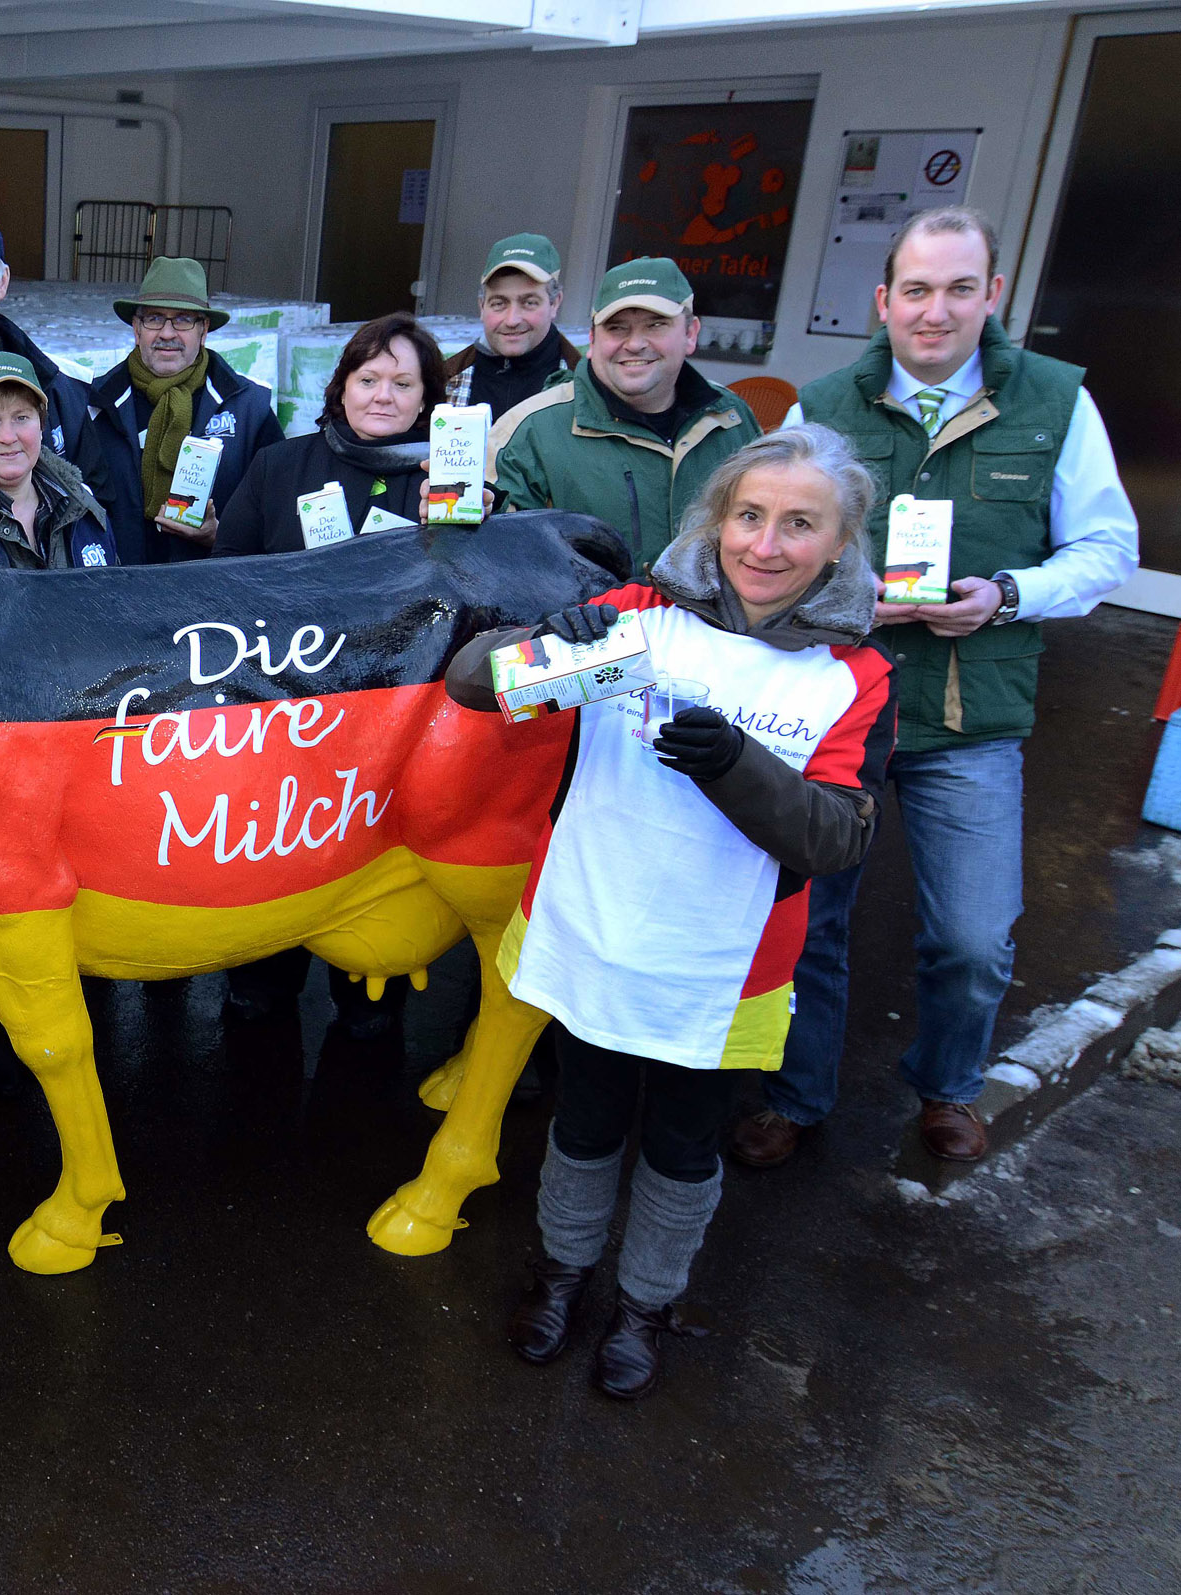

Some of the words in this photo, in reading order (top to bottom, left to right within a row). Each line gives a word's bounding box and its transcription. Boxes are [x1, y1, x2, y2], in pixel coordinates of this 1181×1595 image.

[720, 253, 768, 277] Tafel
[627, 279, 657, 287] KRONE
[450, 438, 472, 449] Die
[435, 446, 466, 458] faire
[444, 456, 479, 467] Milch
[319, 516, 338, 525] Die
[309, 524, 335, 536] faire
[318, 528, 347, 541] Milch
[173, 620, 347, 685] Die
[732, 706, 818, 741] Milch
[93, 687, 345, 786] faire
[158, 767, 393, 866] Milch
